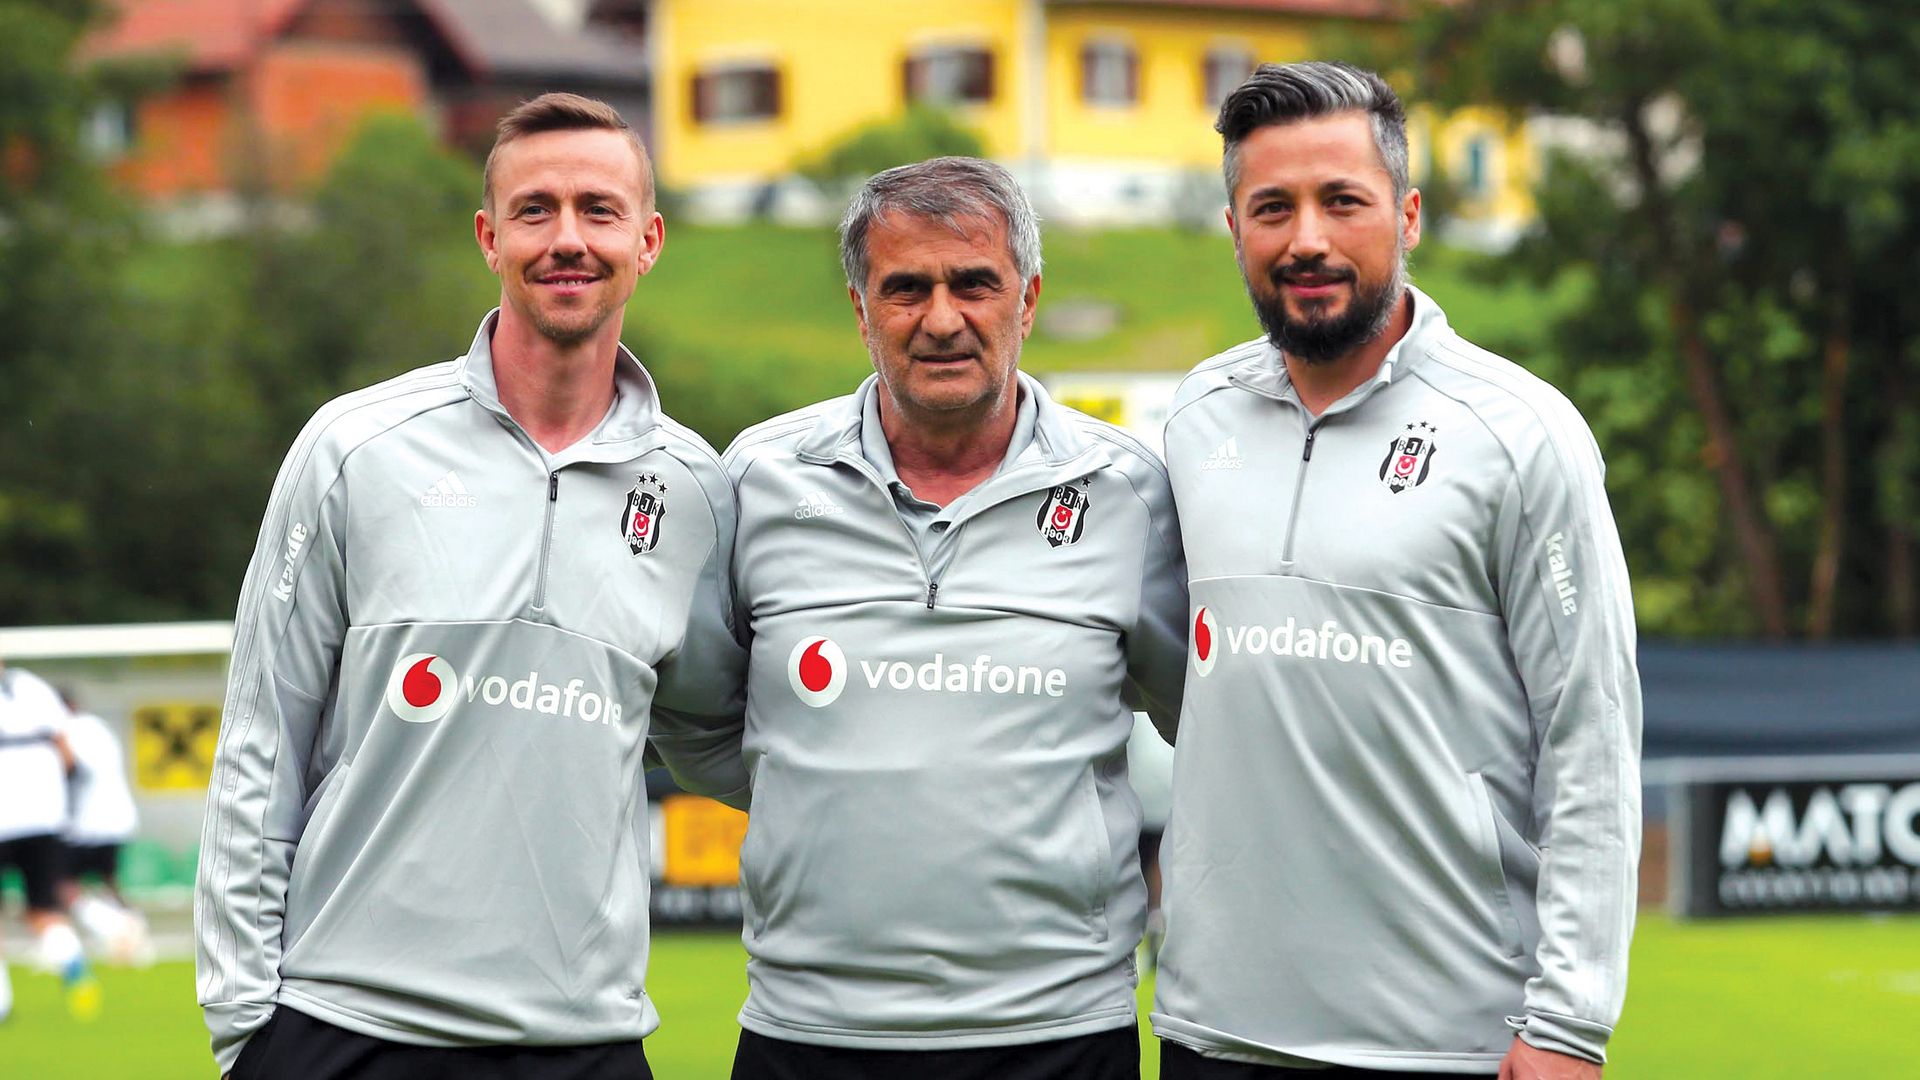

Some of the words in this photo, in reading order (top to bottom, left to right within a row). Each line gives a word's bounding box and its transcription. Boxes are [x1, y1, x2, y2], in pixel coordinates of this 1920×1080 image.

[632, 493, 660, 516] BJK
[1055, 486, 1083, 510] BJK
[627, 534, 649, 551] 1903
[1044, 527, 1070, 544] 1903
[272, 522, 308, 602] kalde
[1545, 531, 1578, 616] kalde
[1226, 616, 1413, 668] vodafone
[859, 652, 1067, 697] vodafone
